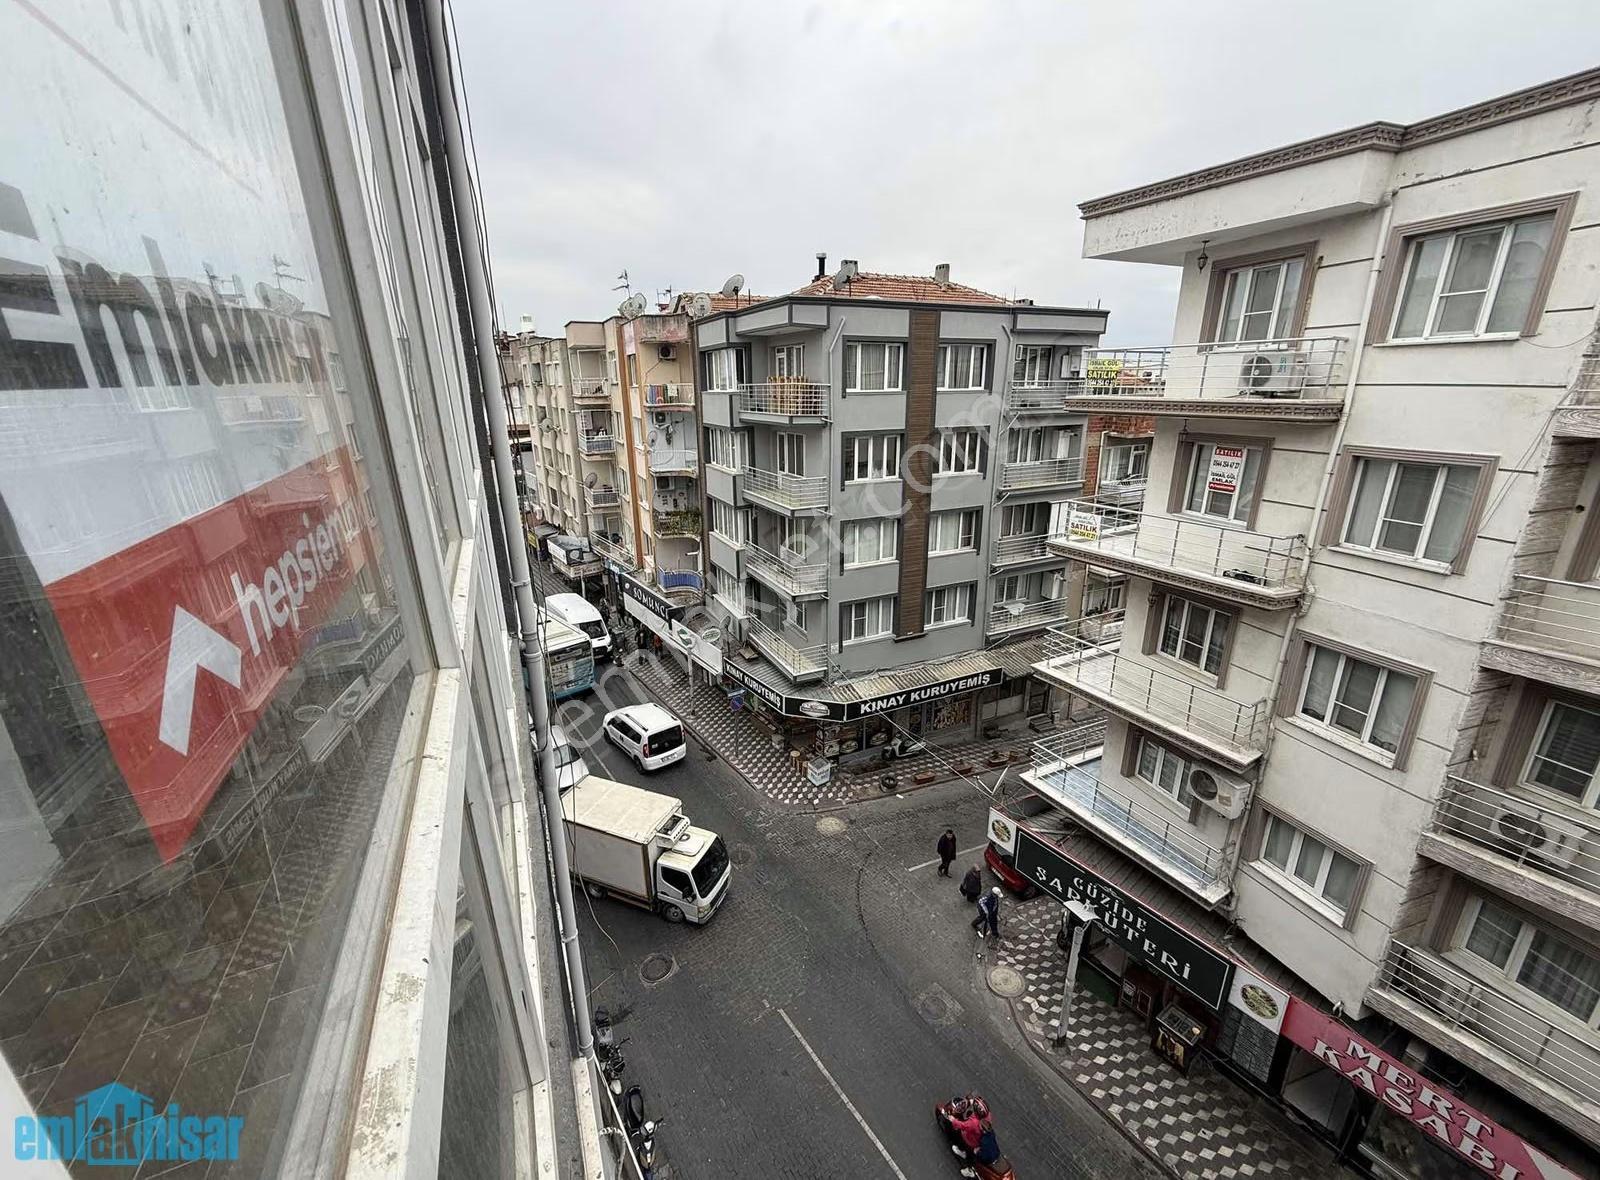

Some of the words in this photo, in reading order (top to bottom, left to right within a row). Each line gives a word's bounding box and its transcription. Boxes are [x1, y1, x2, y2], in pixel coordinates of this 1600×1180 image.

[1088, 370, 1117, 379] SATILIK
[1216, 449, 1242, 457] SATILIK
[1071, 523, 1097, 533] SATILIK
[860, 694, 906, 714] KINAY
[910, 673, 991, 702] KURUYEMİŞ
[1073, 877, 1148, 933] GÜZİDE
[1312, 1037, 1525, 1180] KASABI
[1346, 1039, 1495, 1143] MERT
